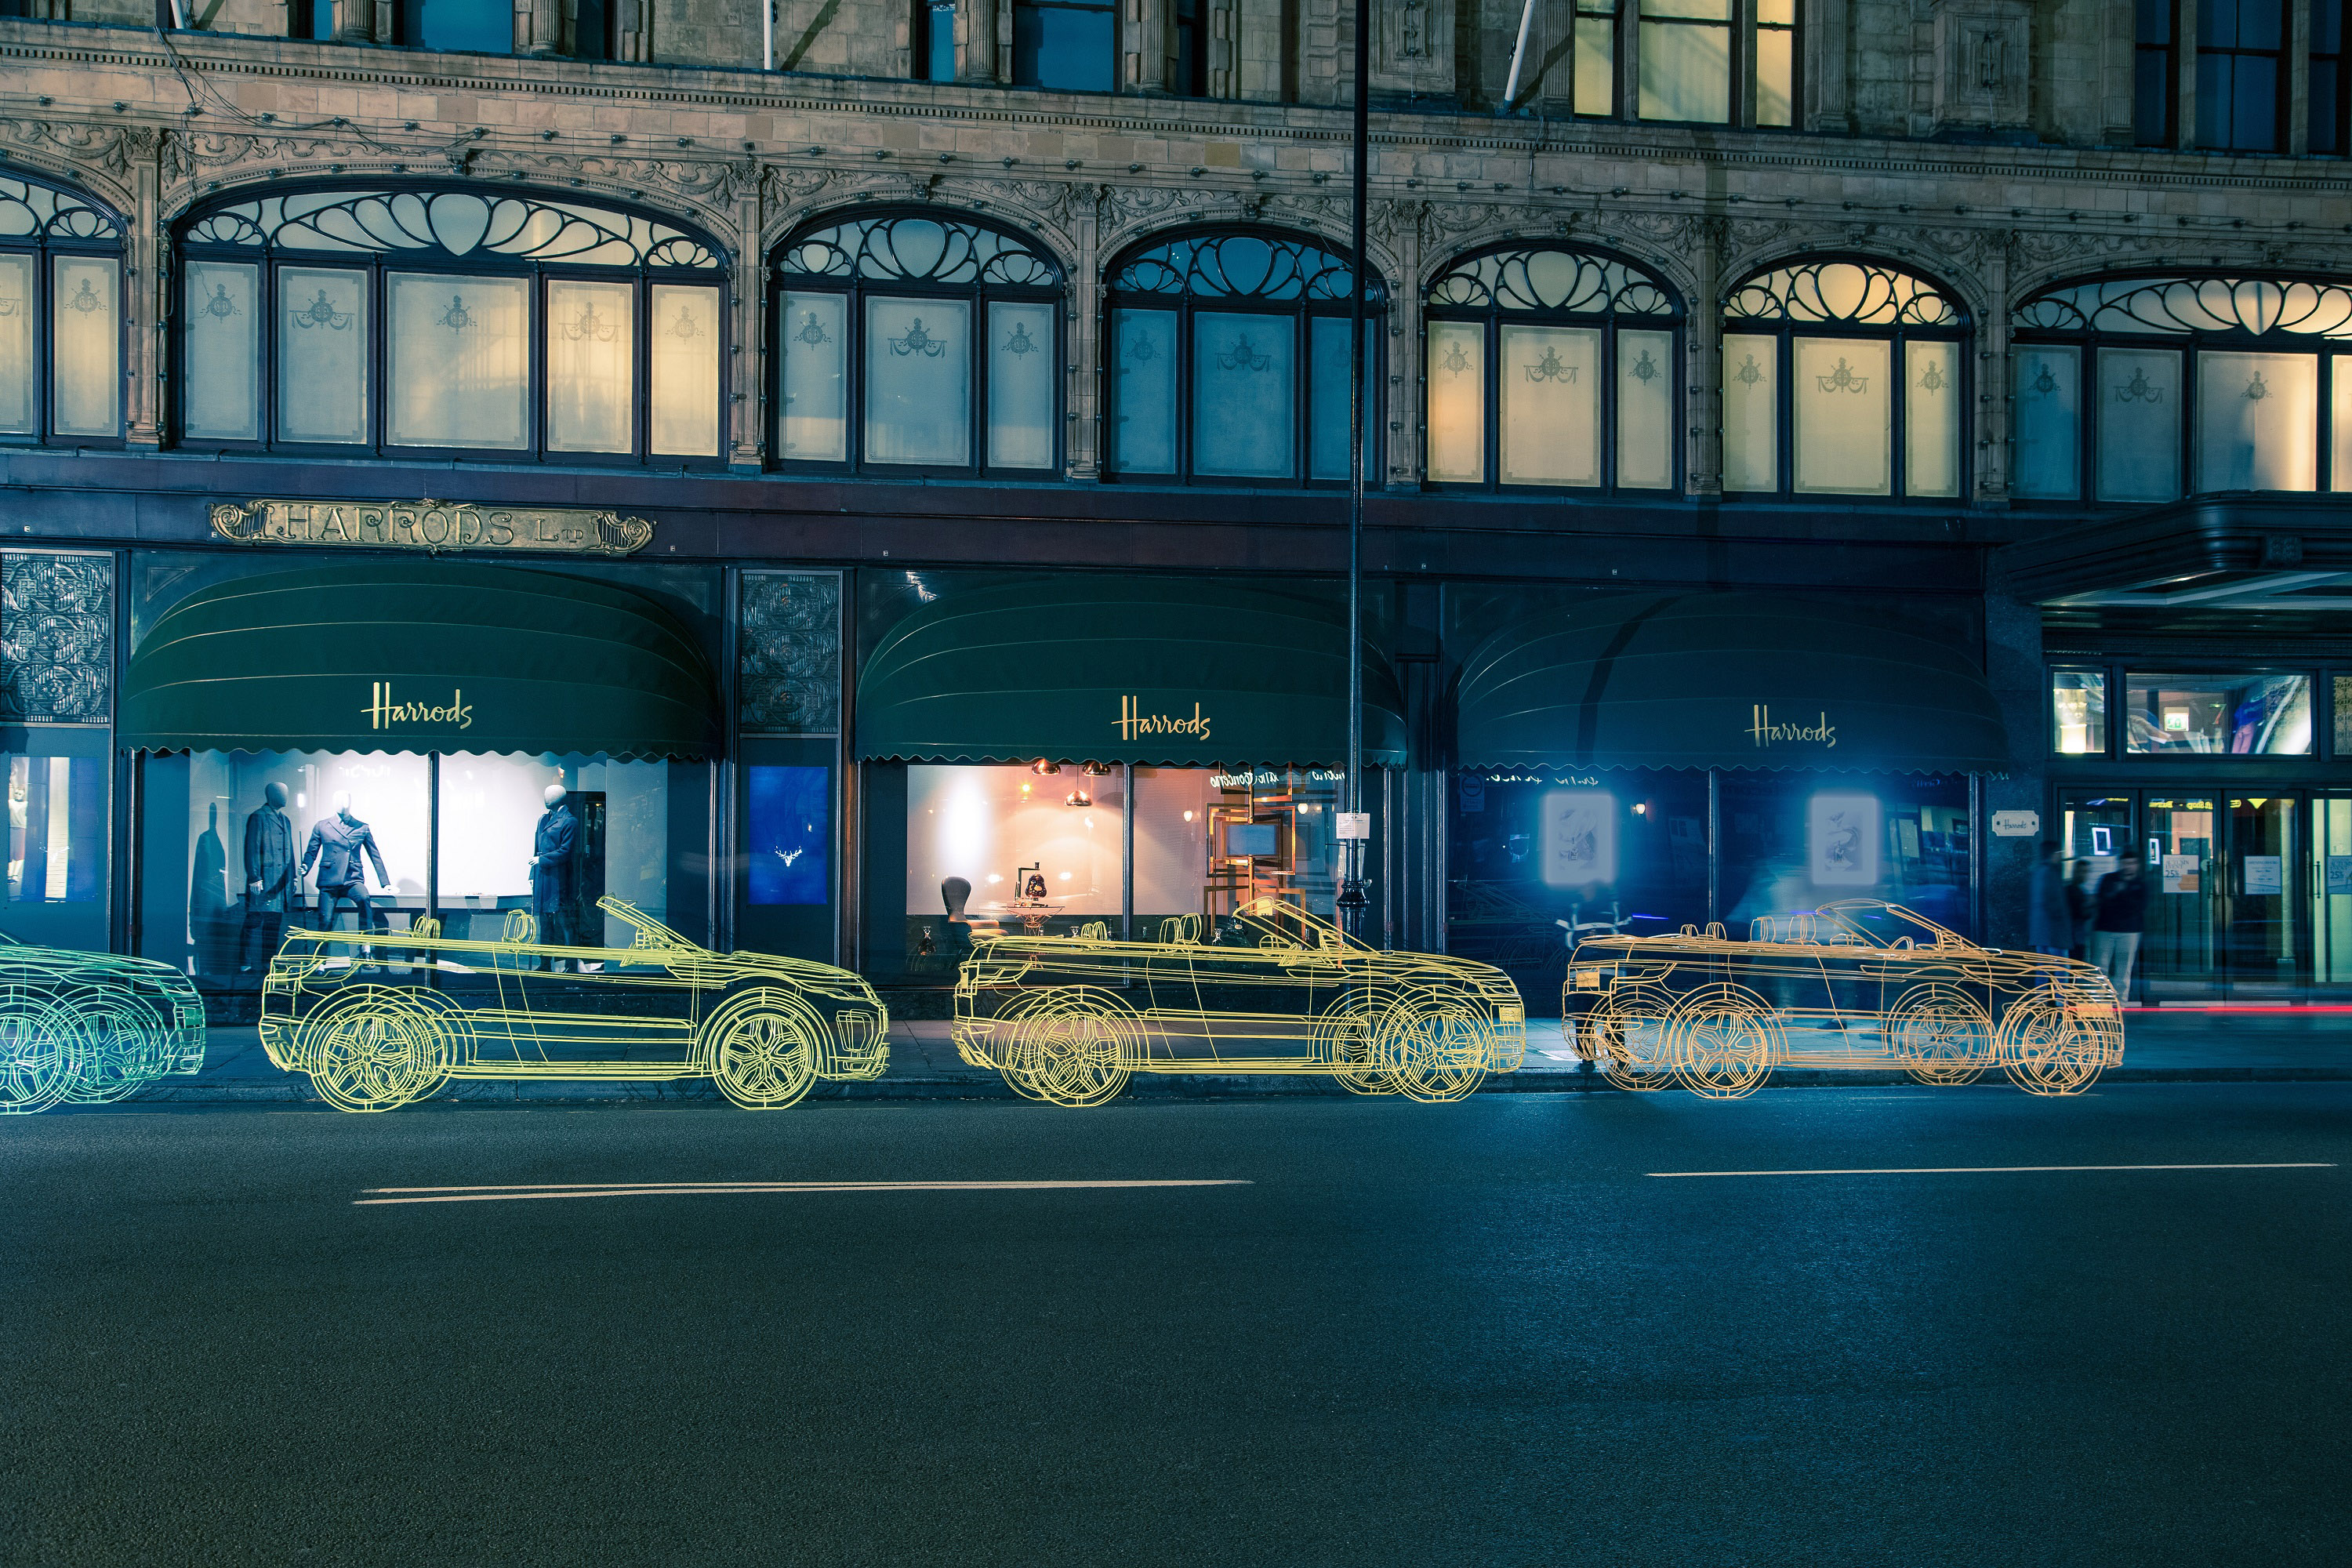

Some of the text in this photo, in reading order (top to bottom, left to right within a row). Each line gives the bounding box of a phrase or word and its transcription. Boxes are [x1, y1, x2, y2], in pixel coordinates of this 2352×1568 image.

[277, 504, 514, 545] HARRODS
[361, 681, 473, 729] Harrods
[1111, 695, 1210, 740] Harrods
[1744, 704, 1836, 748] Harrods
[2002, 818, 2027, 830] Harrods
